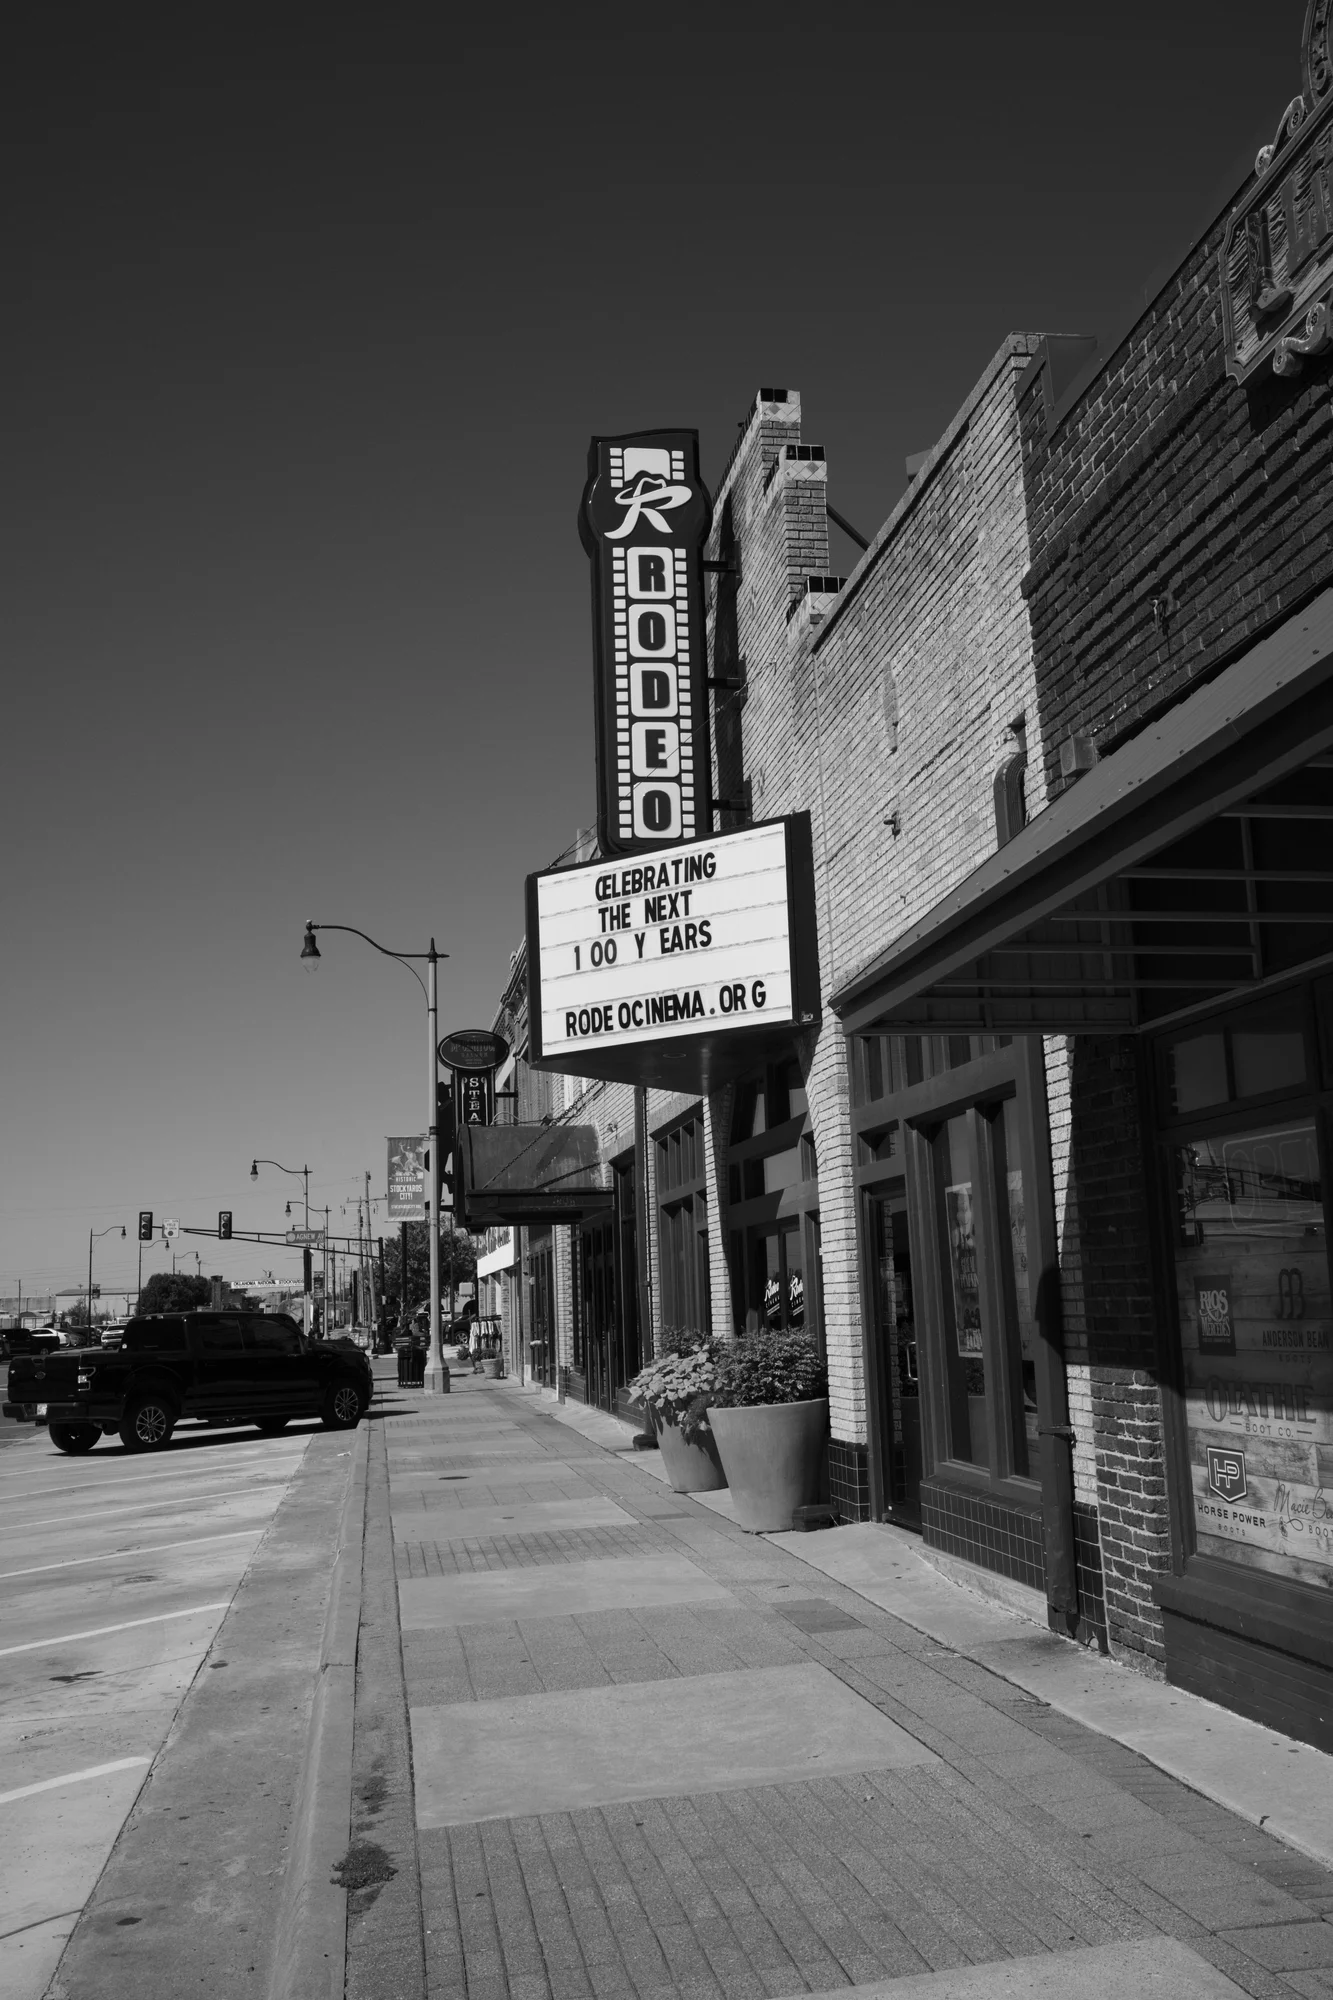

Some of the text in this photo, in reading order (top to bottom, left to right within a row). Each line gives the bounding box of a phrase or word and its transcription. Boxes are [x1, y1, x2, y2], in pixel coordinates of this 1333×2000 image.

[637, 553, 672, 833] RODEO
[595, 852, 717, 902] CELEBRATING
[598, 889, 692, 933] THE NEXT
[468, 1077, 482, 1127] STEA
[389, 1184, 423, 1193] STOCKYARDS
[1199, 1289, 1229, 1315] RIOS
[1262, 1330, 1330, 1349] ANDERSON BEAN
[1278, 1353, 1313, 1364] BOOTS
[1205, 1375, 1317, 1424] OLATHE
[1245, 1422, 1294, 1438] BOOT CO.
[1197, 1503, 1266, 1528] HORSE POWER
[1218, 1523, 1246, 1537] BOOTS
